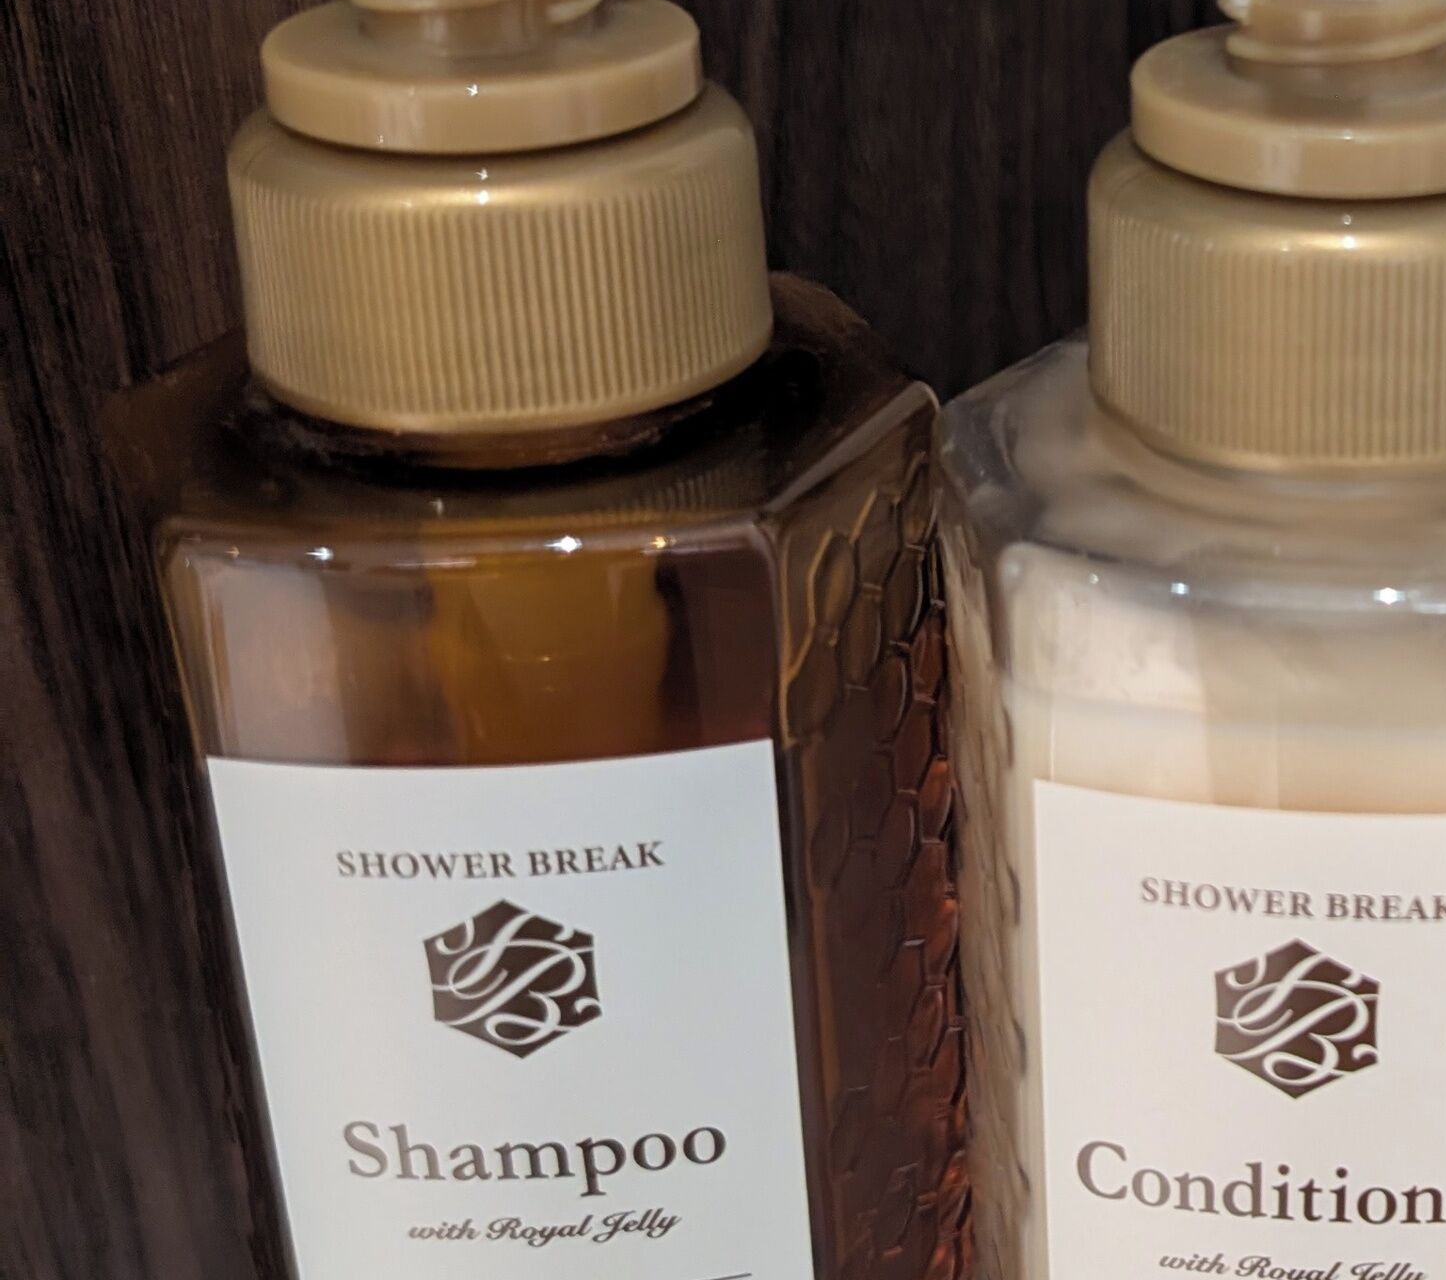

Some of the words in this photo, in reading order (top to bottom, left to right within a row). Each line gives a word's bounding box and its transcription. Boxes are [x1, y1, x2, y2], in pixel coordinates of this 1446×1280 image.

[336, 850, 517, 880] SHOWER
[527, 839, 667, 878] BREAK
[1140, 877, 1316, 920] SHOWER
[343, 1120, 727, 1197] Shampoo
[407, 1217, 482, 1242] with
[484, 1212, 595, 1249] Royal
[591, 1206, 684, 1245] Jelly
[1157, 1251, 1231, 1276] with
